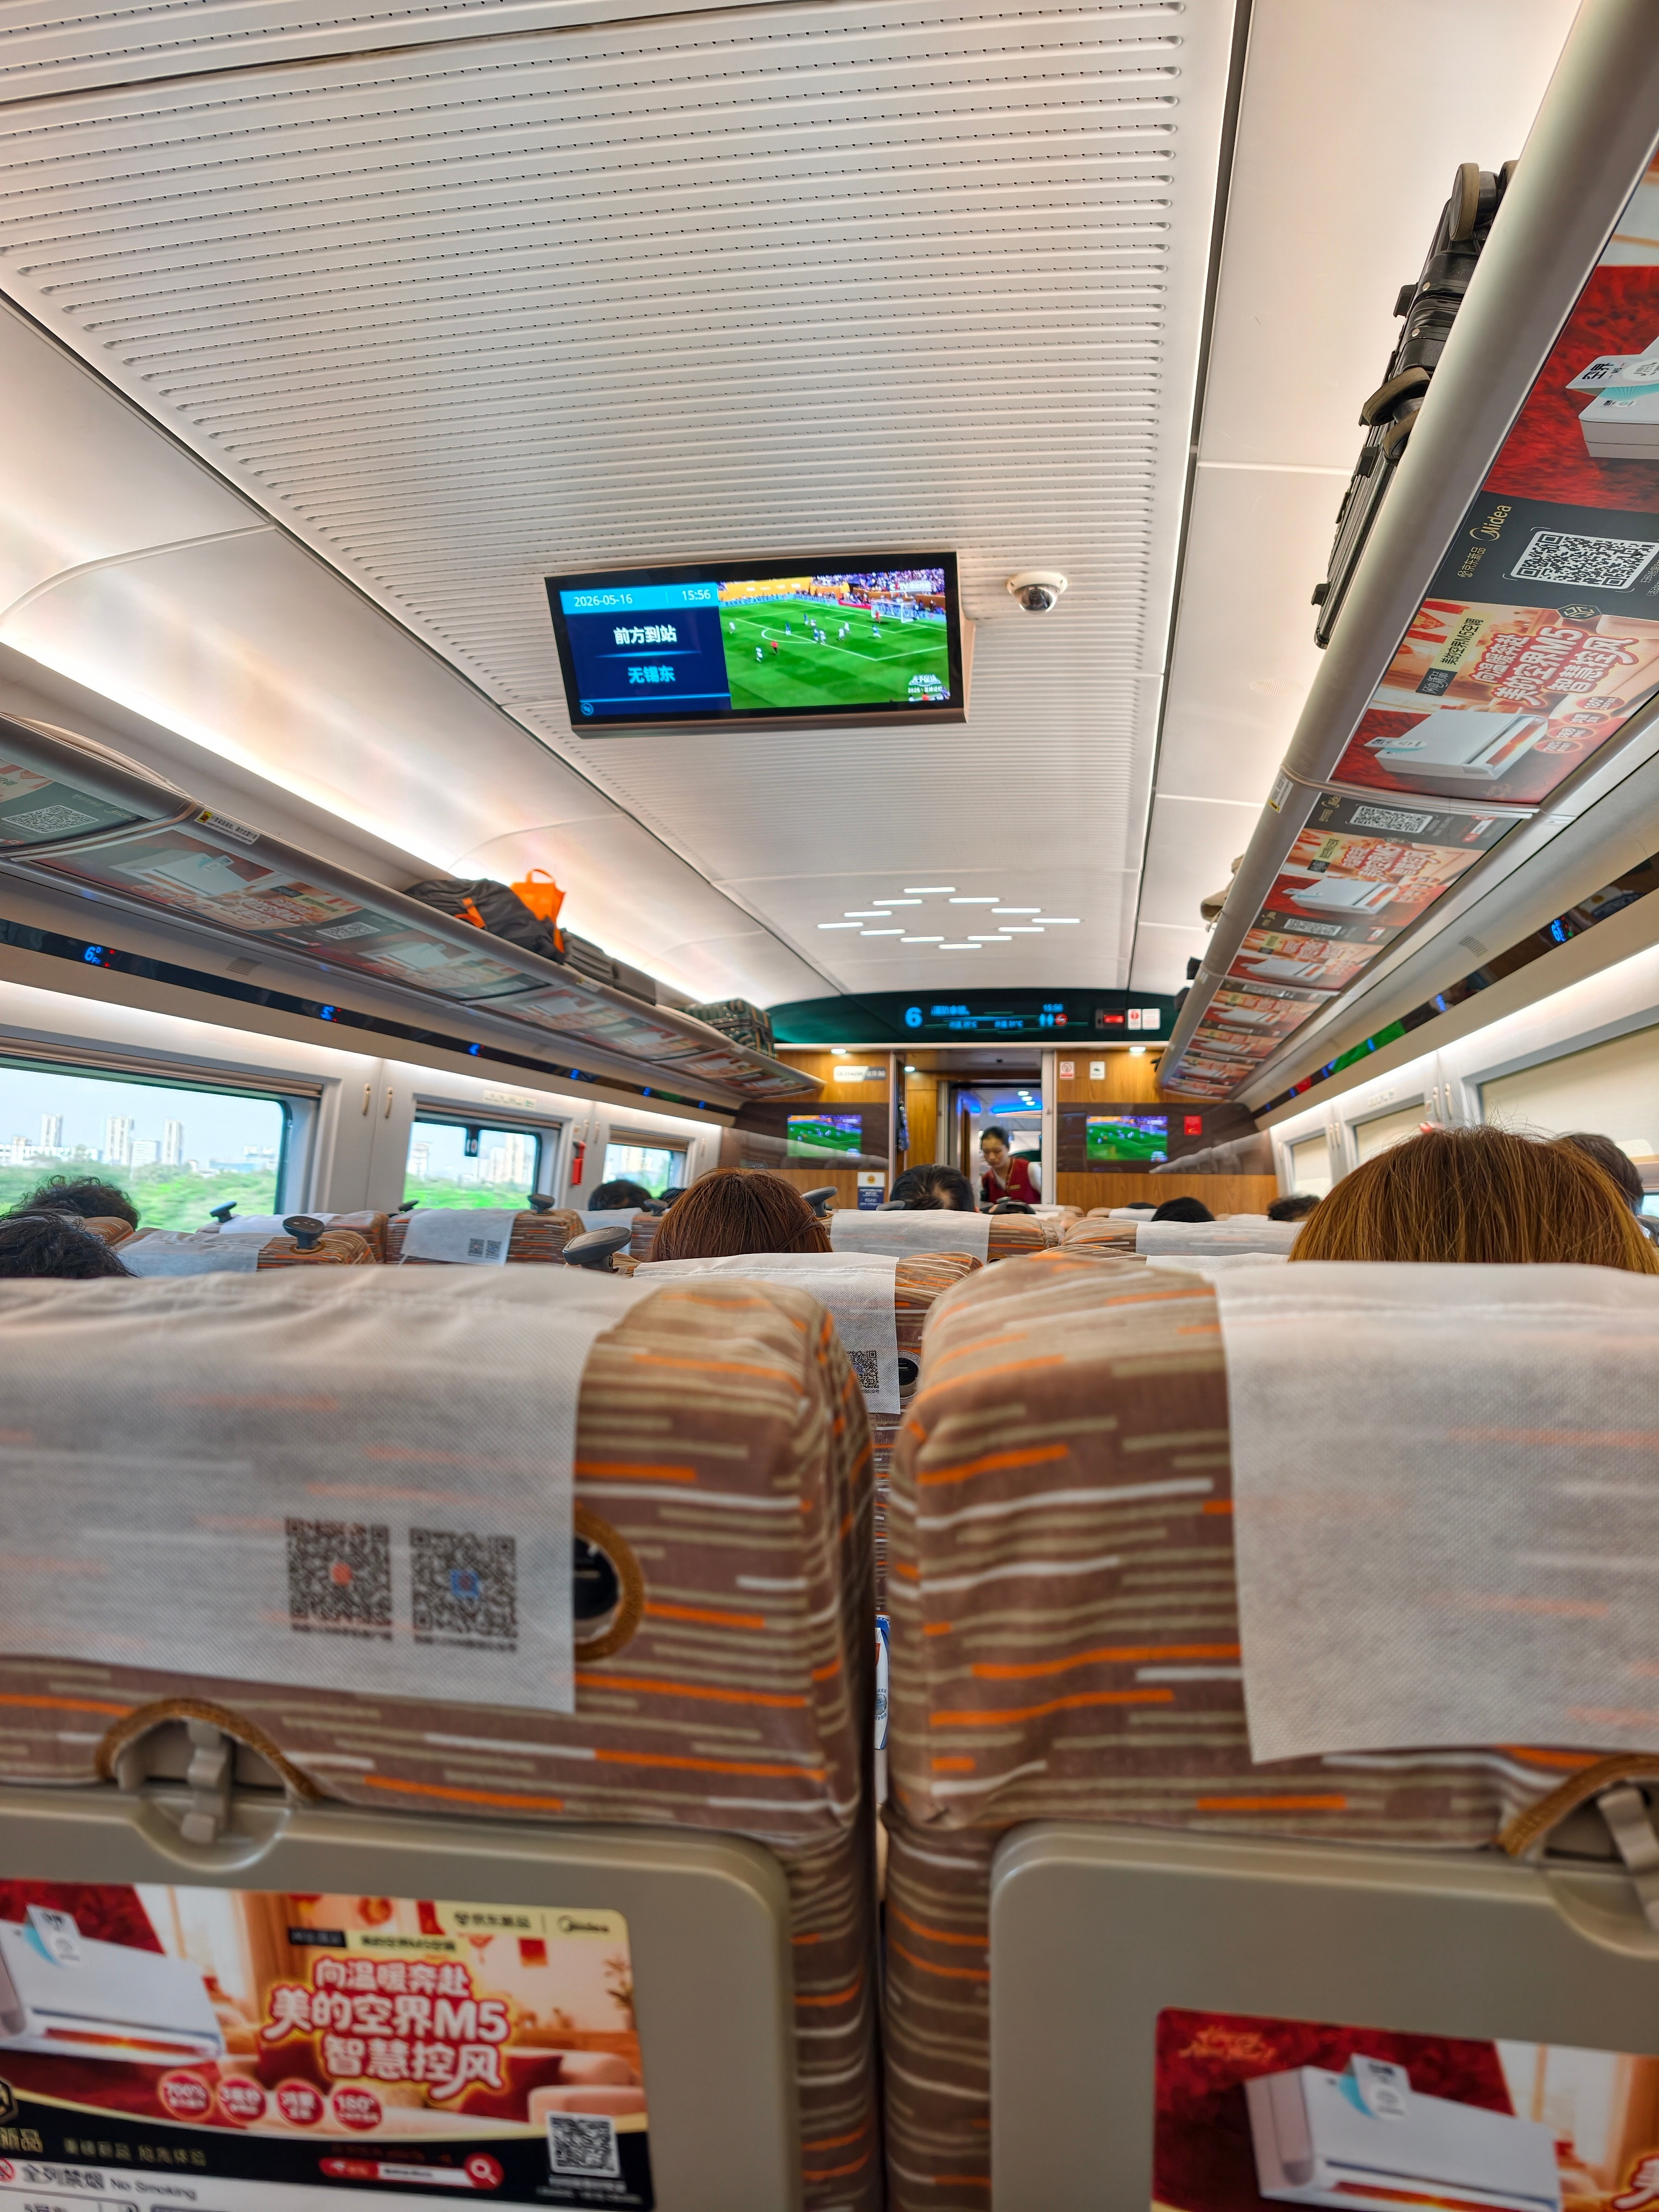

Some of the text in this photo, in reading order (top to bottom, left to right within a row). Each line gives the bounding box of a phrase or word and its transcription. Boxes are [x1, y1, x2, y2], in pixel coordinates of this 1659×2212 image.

[1582, 363, 1615, 380] 空界
[1469, 504, 1512, 542] Midea
[1461, 547, 1486, 574] 京东新品
[574, 589, 711, 607] 2026-05-16 15:56
[613, 624, 678, 645] 前方到站
[1439, 617, 1484, 665] 美的空界M5空调
[628, 665, 676, 684] 无锡东
[1472, 633, 1530, 684] 向温暖奔赴
[1494, 626, 1585, 707] 美的空界M5
[1547, 636, 1635, 693] 智慧控风
[84, 946, 96, 961] 6
[905, 1007, 923, 1028] 6
[315, 1958, 471, 1998] 向温暖奔赴
[262, 1987, 509, 2041] 美的空界M5
[324, 2032, 503, 2099] 智慧控风
[110, 2177, 132, 2191] No
[134, 2181, 198, 2202] Smoking
